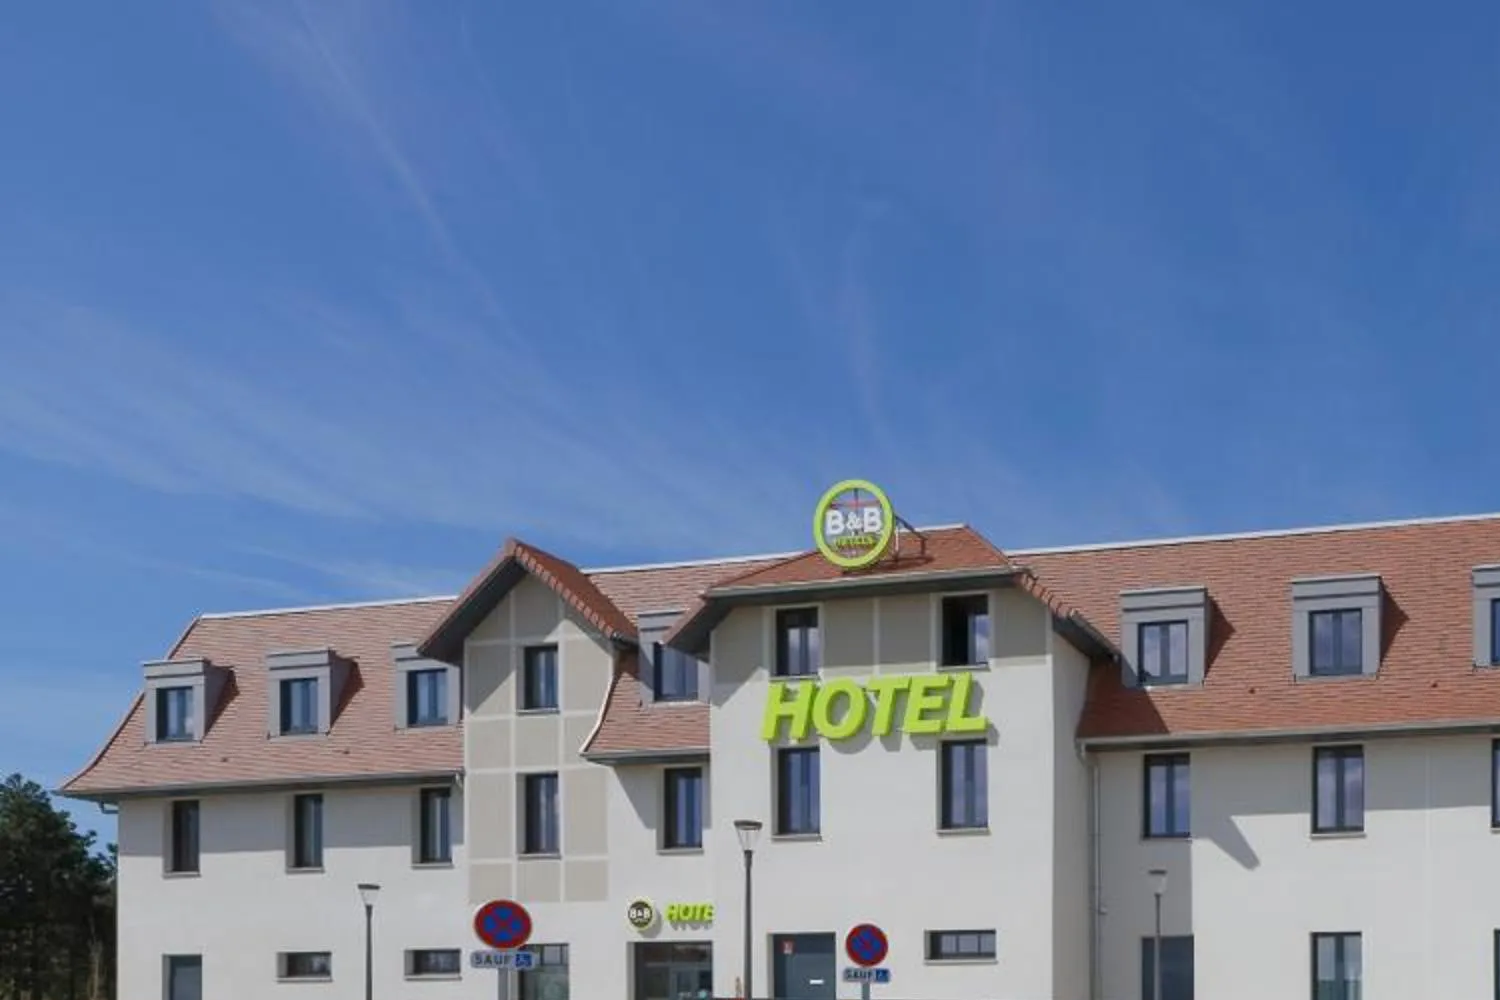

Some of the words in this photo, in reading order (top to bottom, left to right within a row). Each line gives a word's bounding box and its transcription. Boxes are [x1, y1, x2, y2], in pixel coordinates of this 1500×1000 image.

[825, 507, 882, 536] B&B
[761, 671, 988, 740] HOTEL
[629, 907, 651, 919] B&B
[665, 902, 714, 923] HOTE
